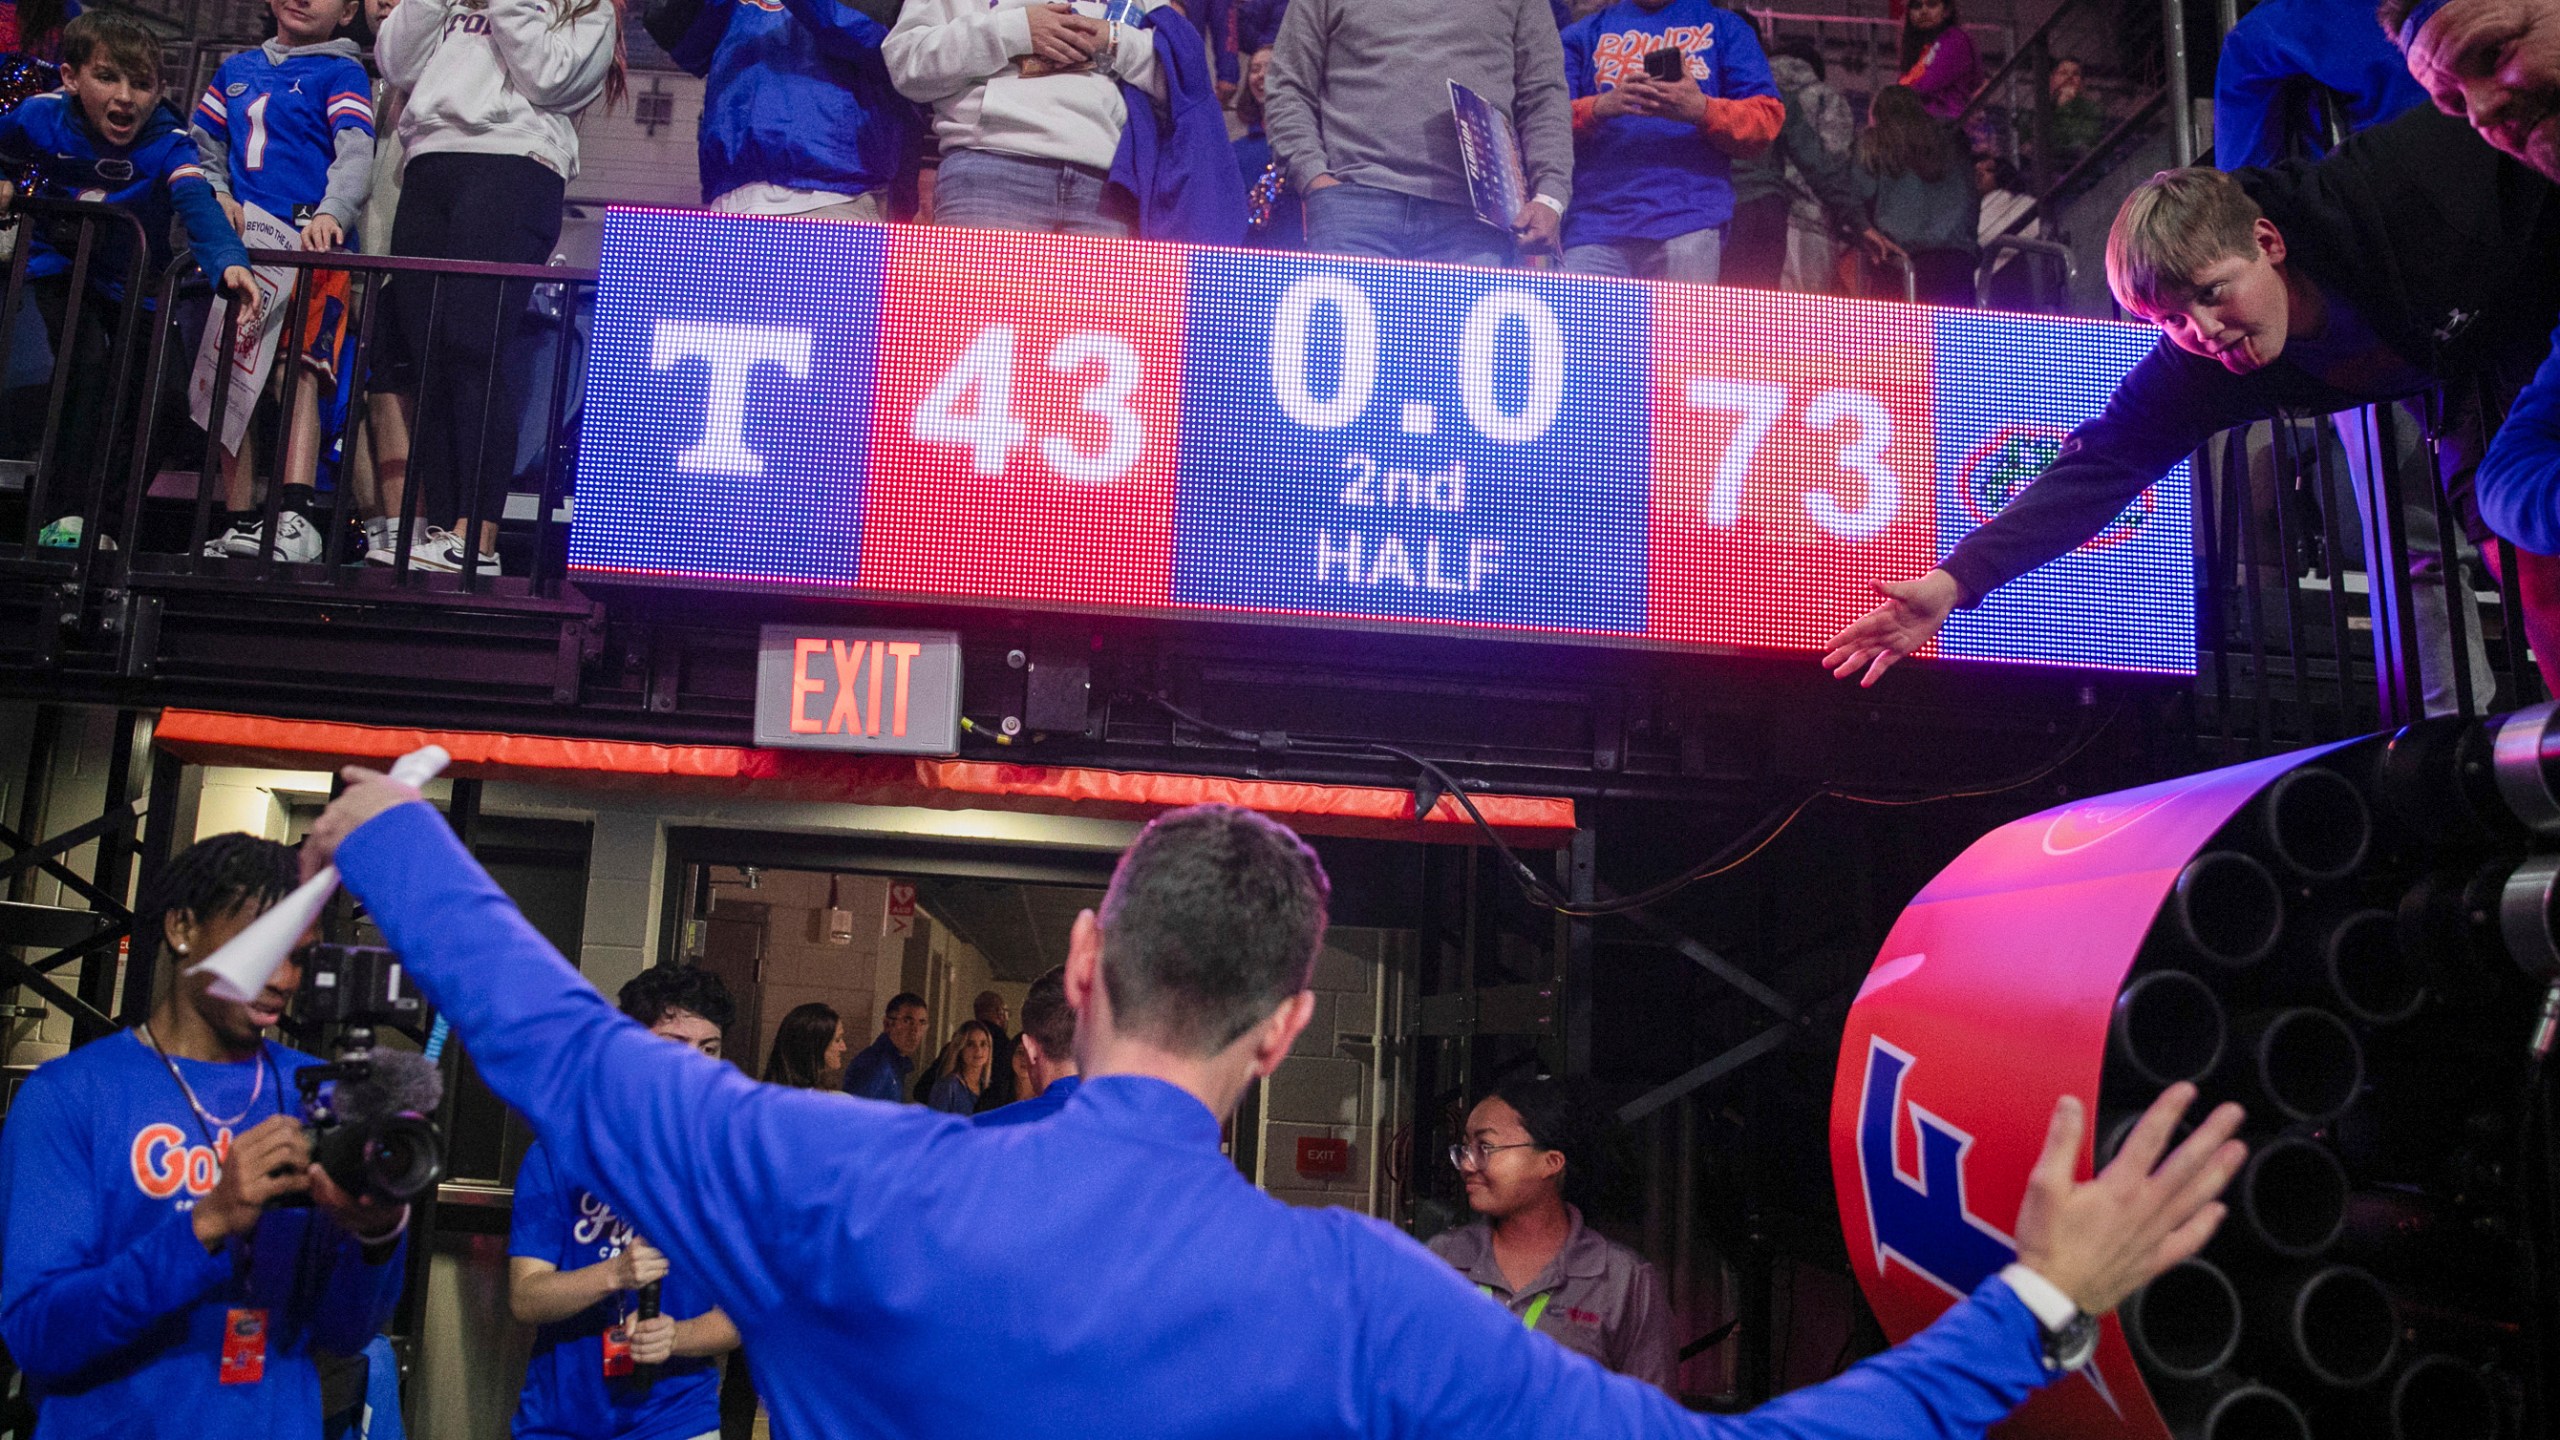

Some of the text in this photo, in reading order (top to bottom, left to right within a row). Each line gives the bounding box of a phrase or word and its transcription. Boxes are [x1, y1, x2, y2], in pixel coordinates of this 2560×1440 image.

[246, 93, 270, 170] 1
[246, 220, 275, 236] BEYOND
[274, 229, 287, 247] THE
[649, 319, 813, 474] T
[1269, 272, 1566, 445] 0.0
[911, 321, 1146, 487] 43
[1339, 455, 1467, 513] 2nd
[1686, 376, 1904, 541] 73
[1316, 529, 1504, 592] HALF
[789, 637, 921, 738] EXIT
[1307, 1149, 1336, 1160] EXIT
